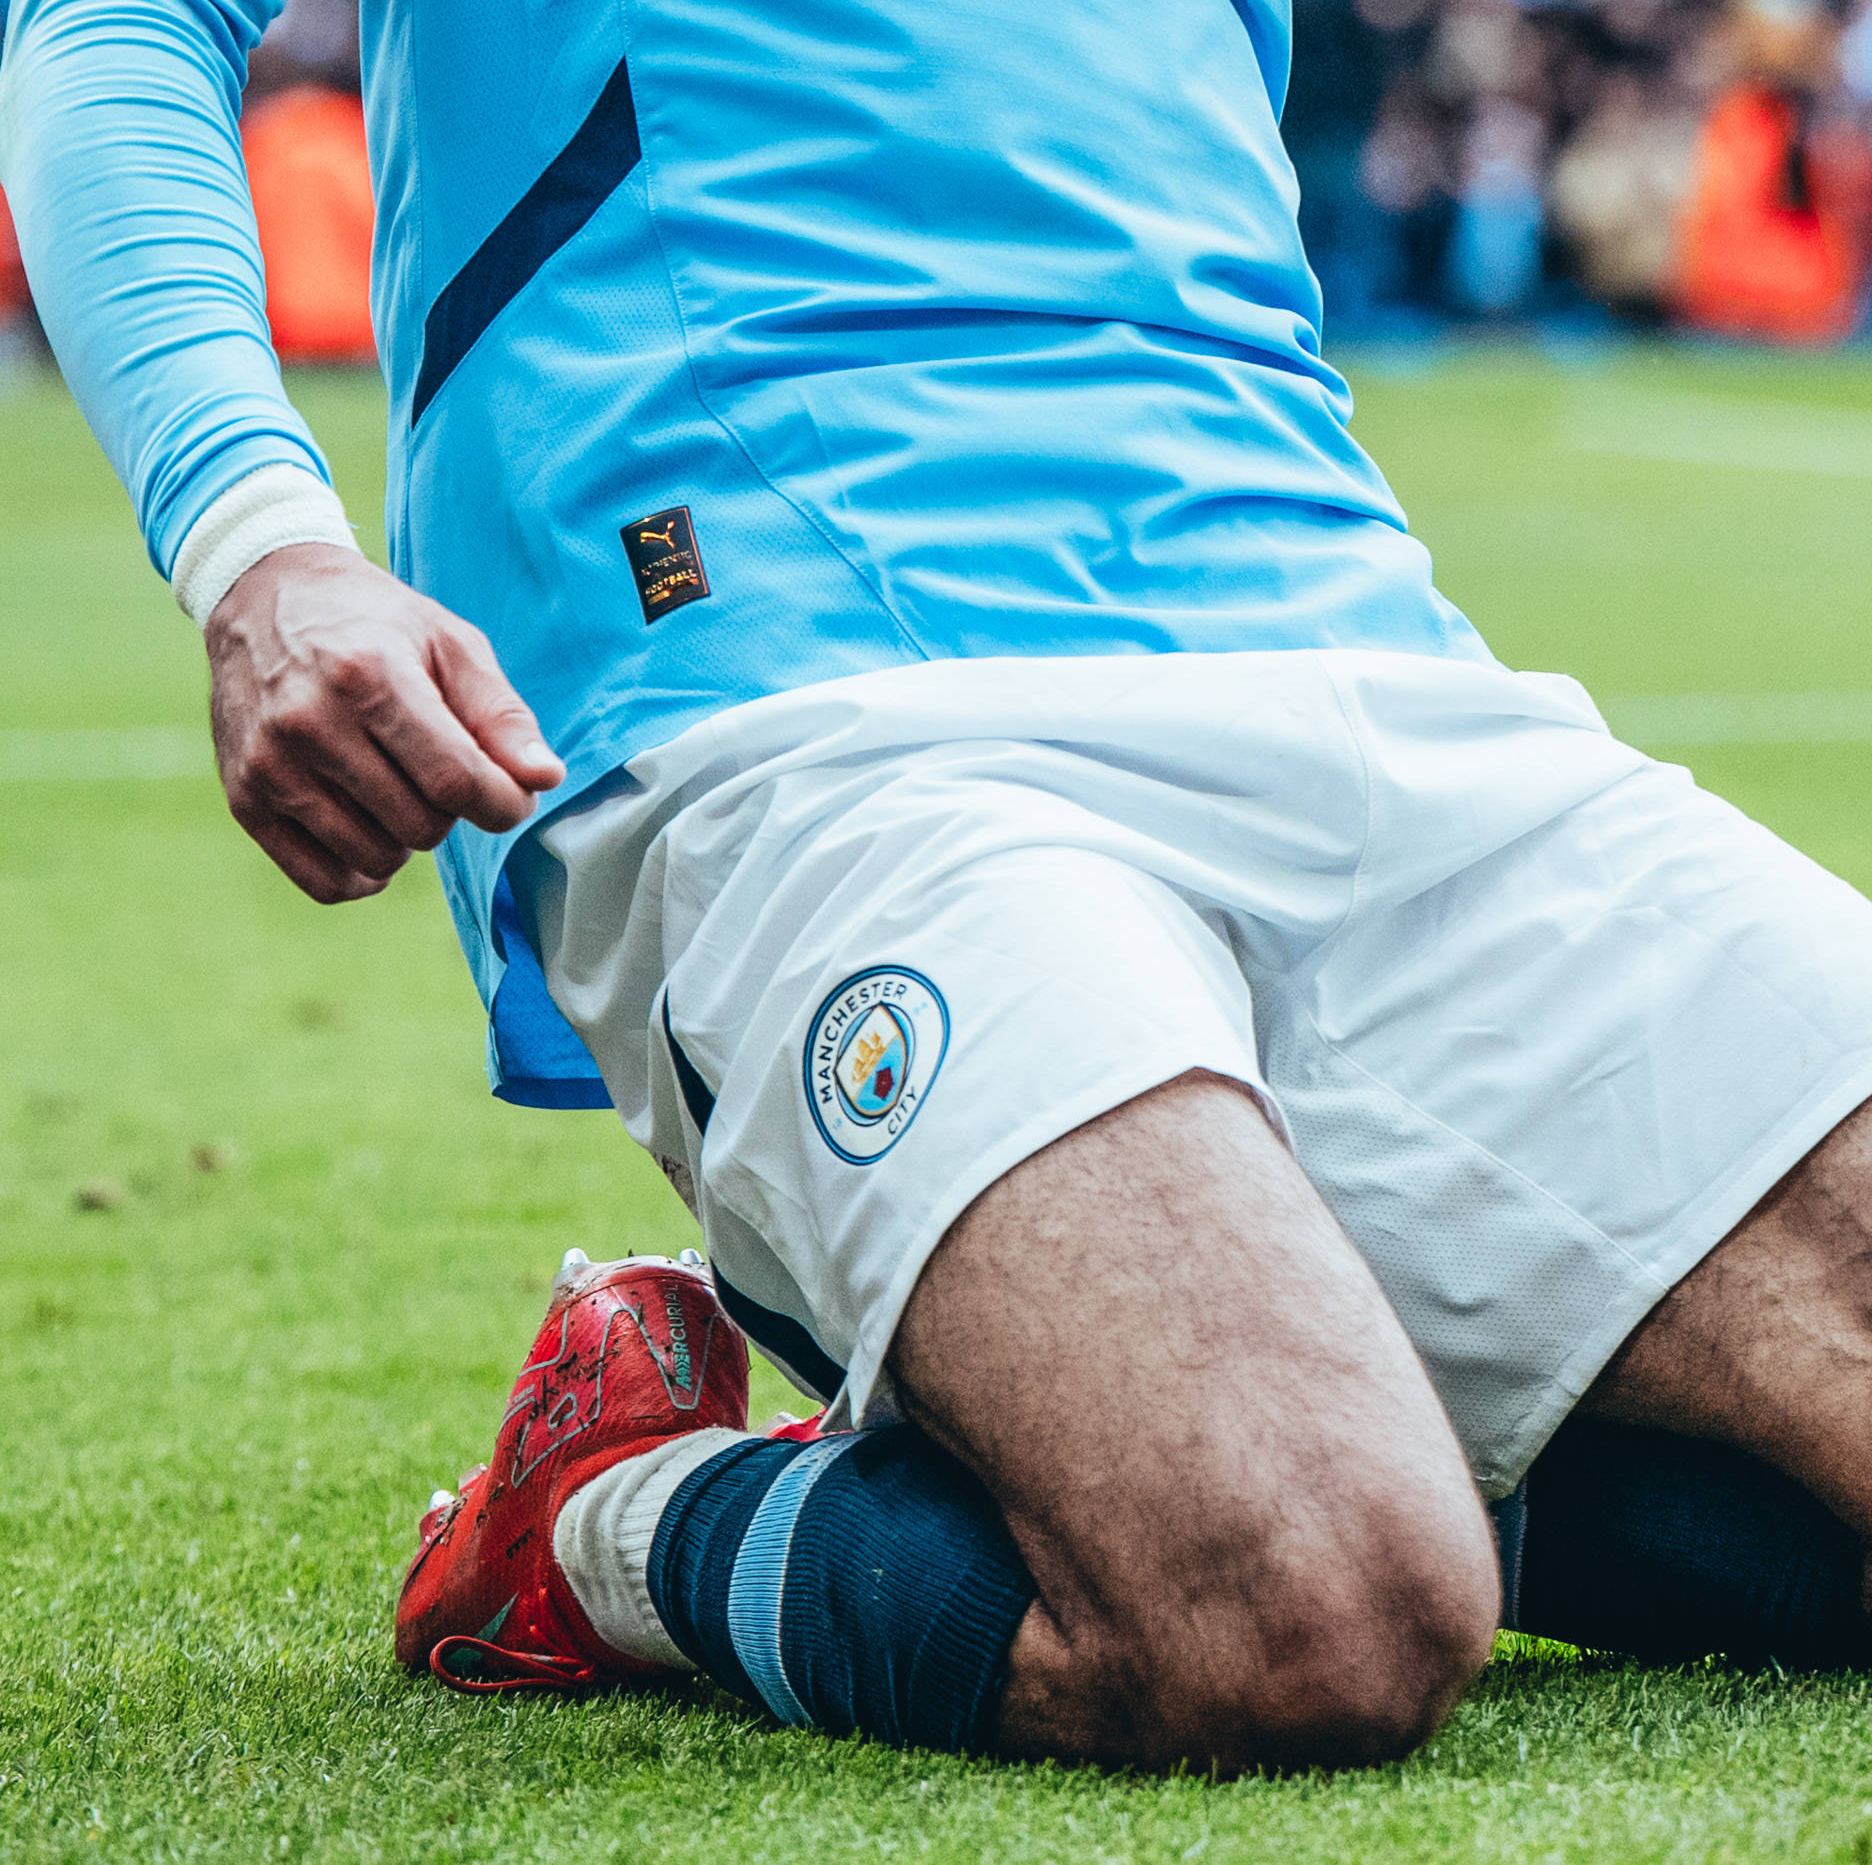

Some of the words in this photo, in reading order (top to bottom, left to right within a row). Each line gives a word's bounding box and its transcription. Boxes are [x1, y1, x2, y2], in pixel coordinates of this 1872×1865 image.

[817, 981, 909, 1105] MANCHESTER
[886, 1087, 918, 1136] CITY
[664, 1284, 692, 1392] MERCURIAL
